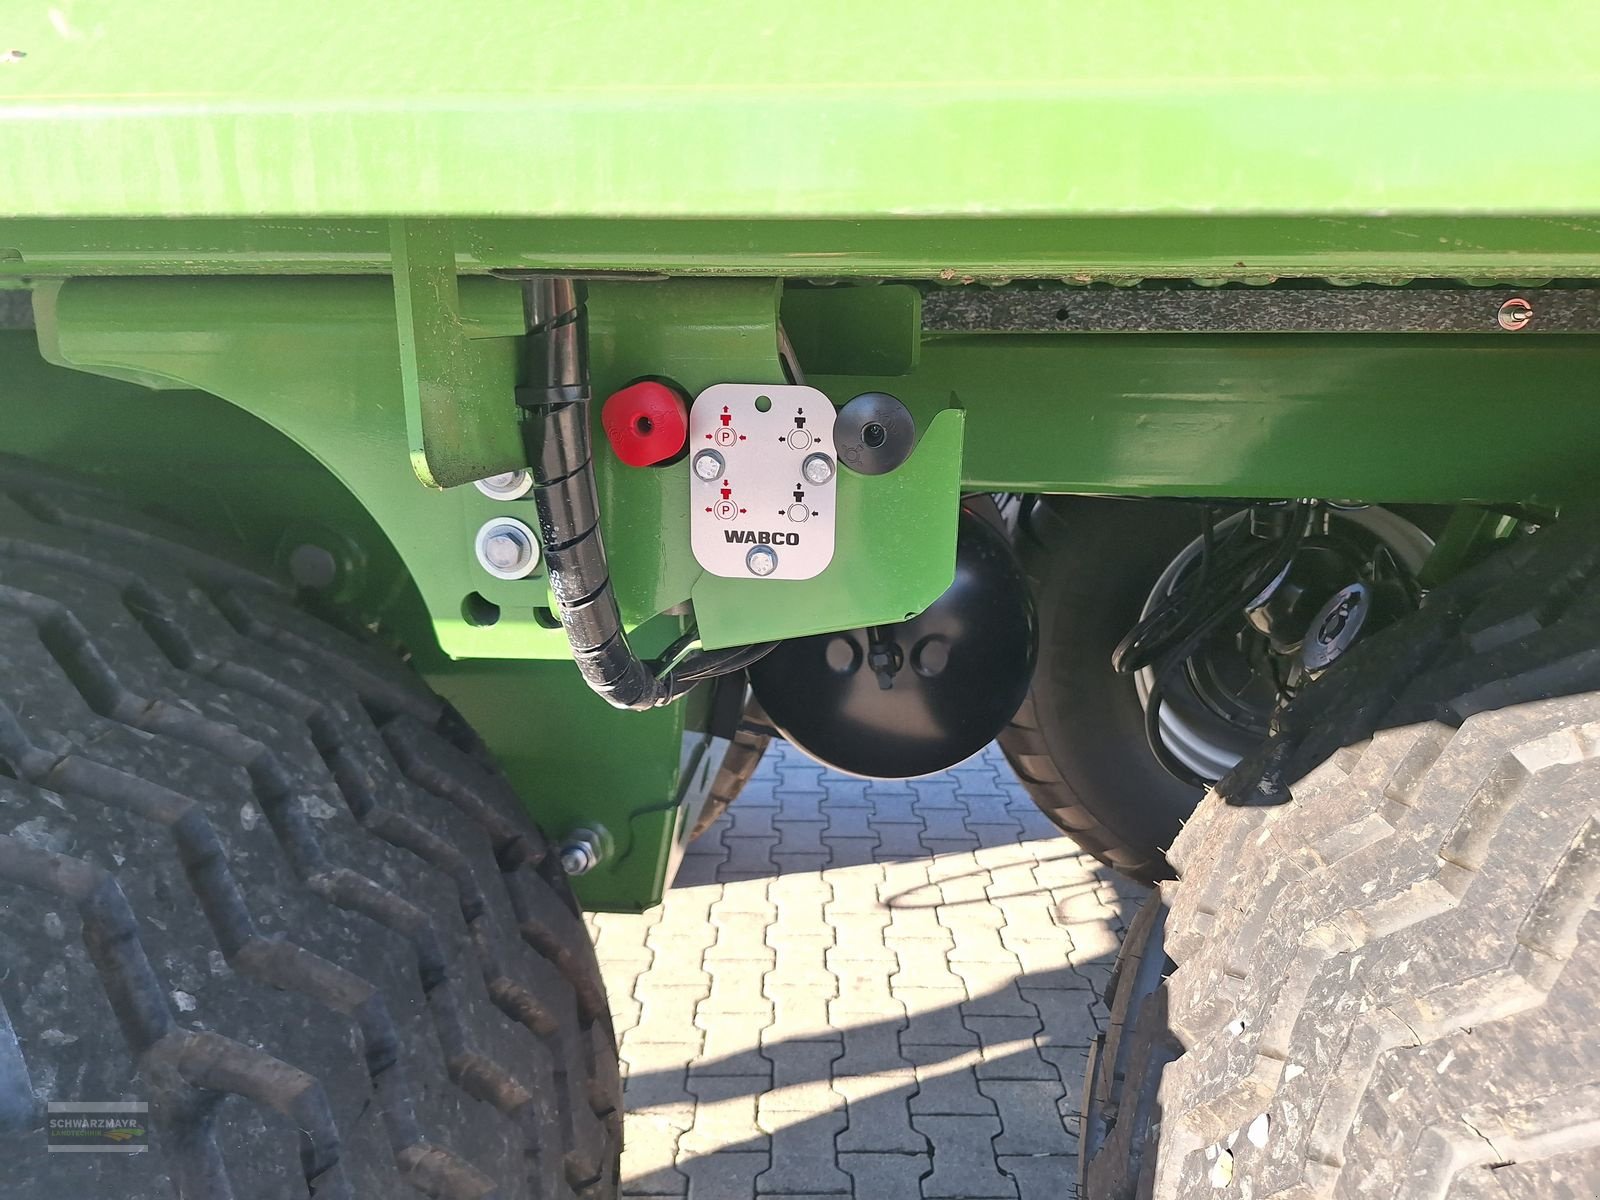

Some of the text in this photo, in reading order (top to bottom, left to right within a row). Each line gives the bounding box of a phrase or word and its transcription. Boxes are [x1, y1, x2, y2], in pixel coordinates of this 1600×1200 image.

[722, 432, 730, 441] P
[722, 505, 730, 514] P
[724, 529, 799, 545] WABCO
